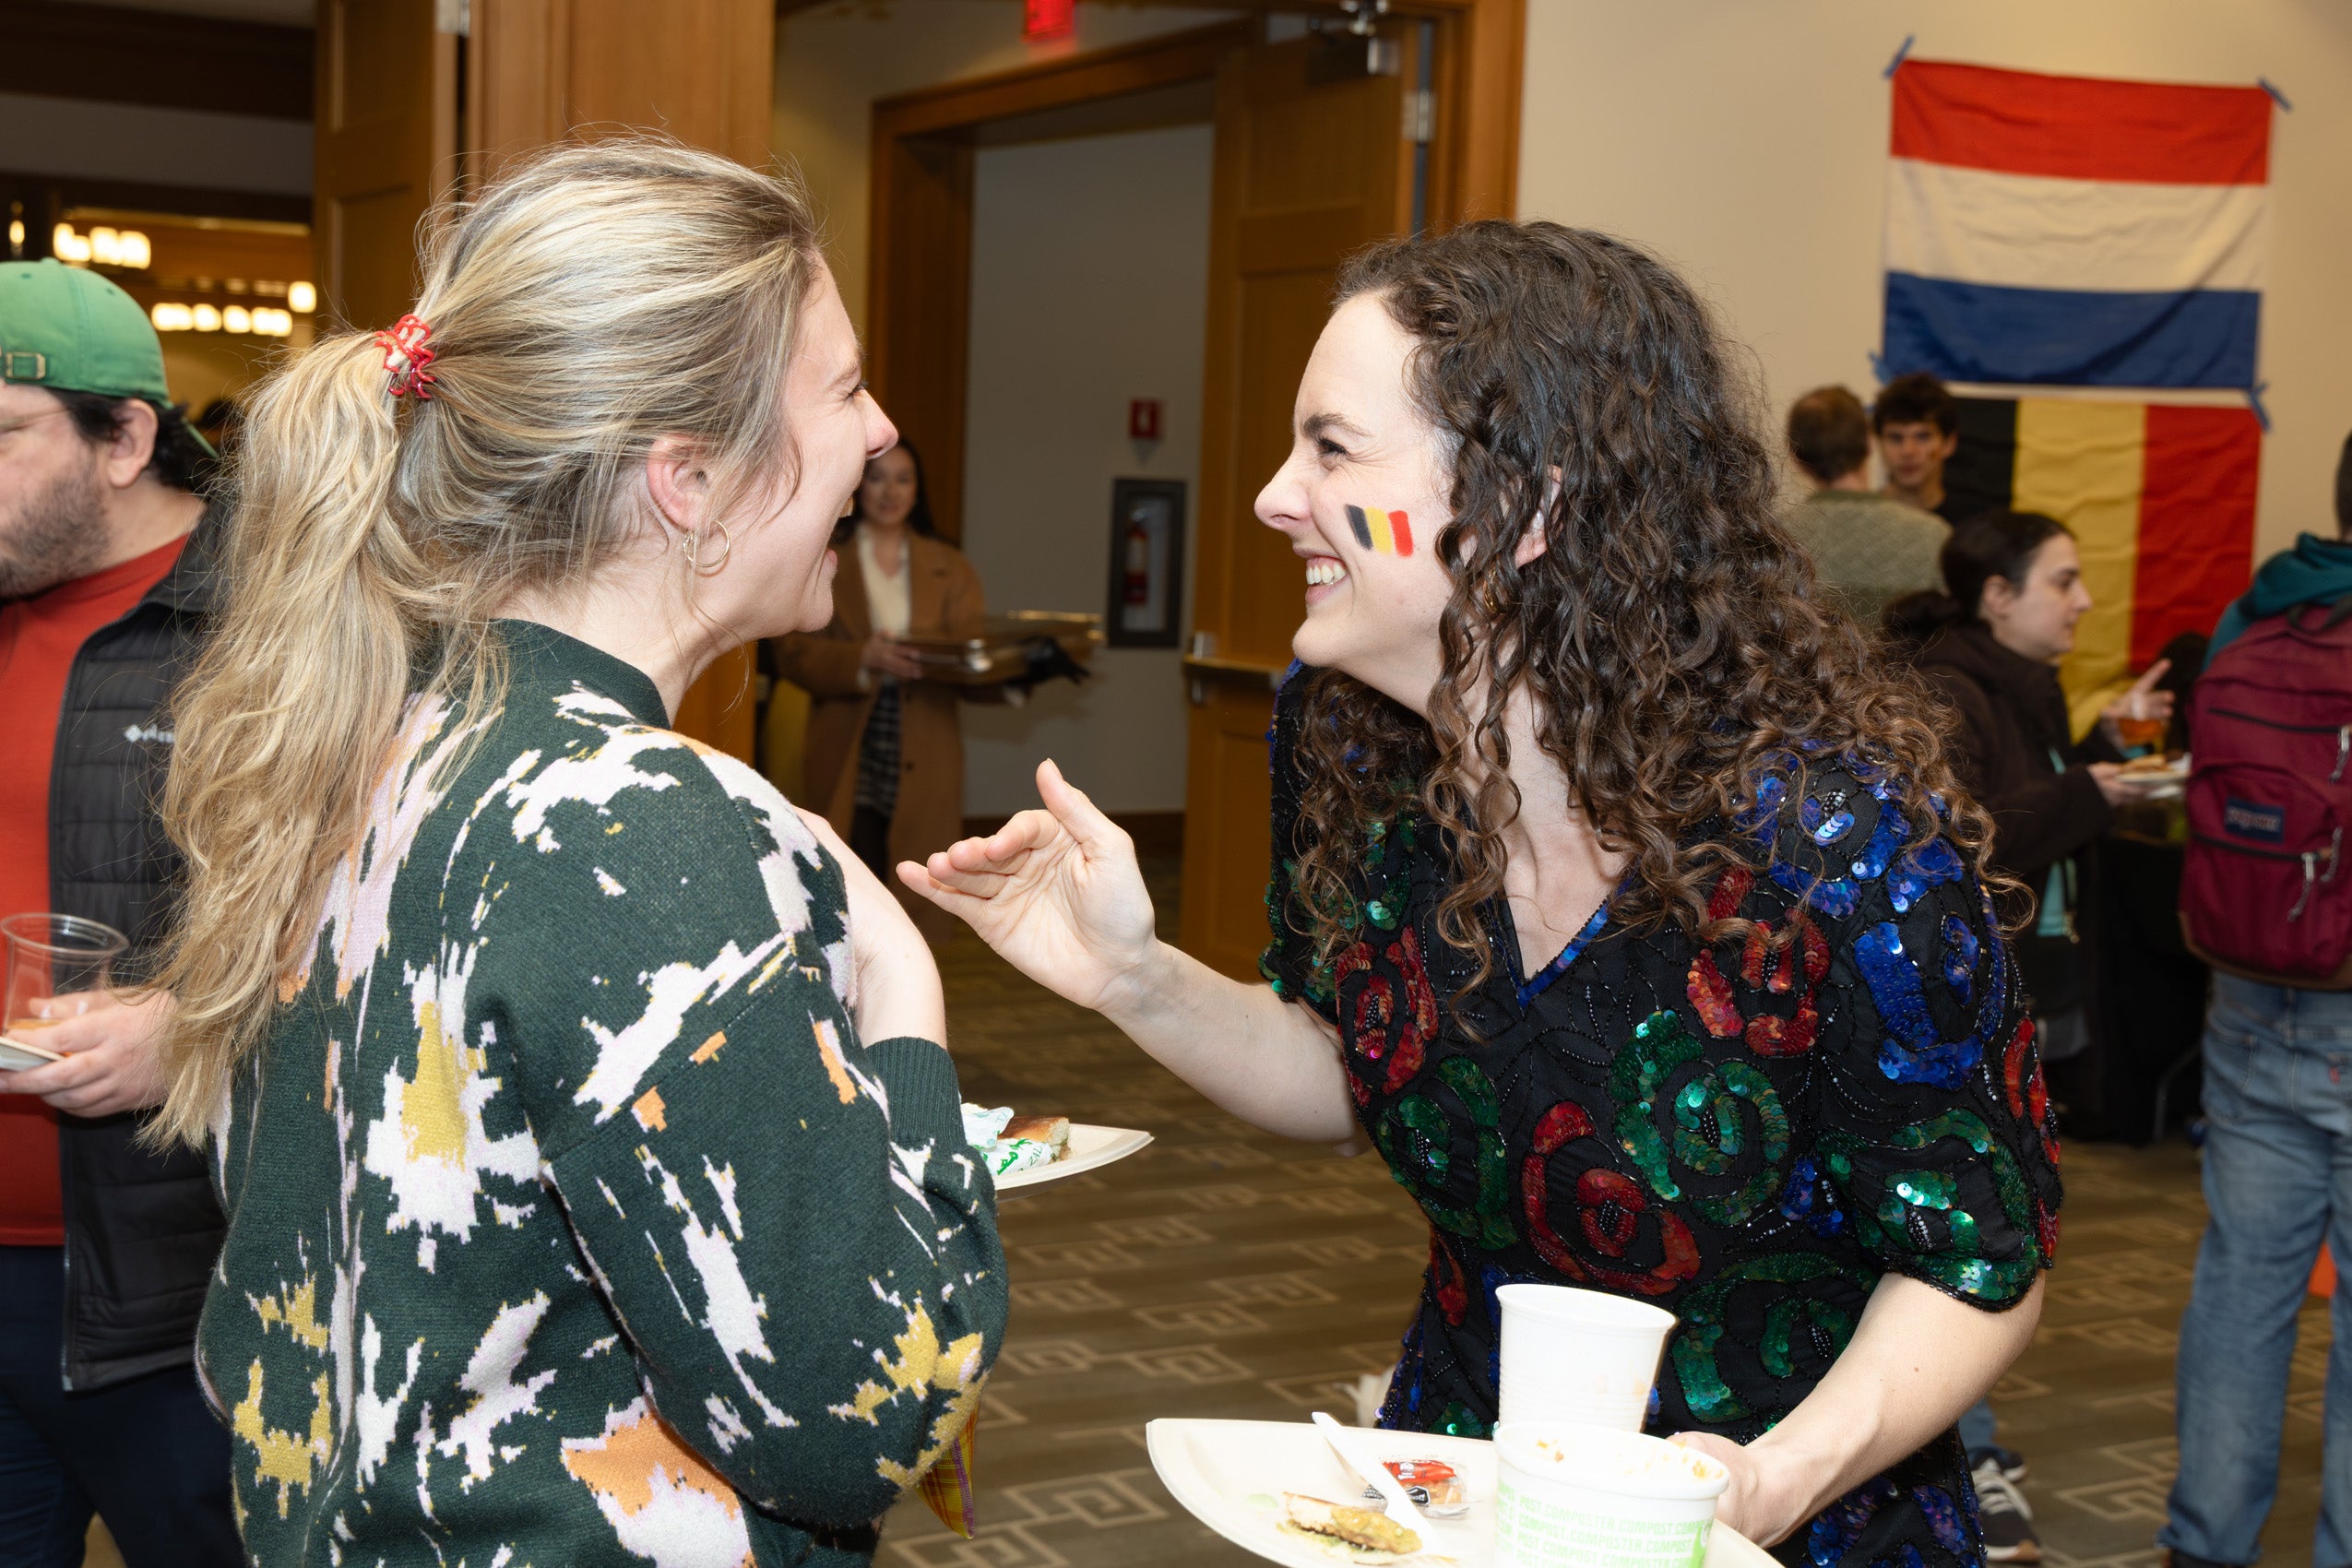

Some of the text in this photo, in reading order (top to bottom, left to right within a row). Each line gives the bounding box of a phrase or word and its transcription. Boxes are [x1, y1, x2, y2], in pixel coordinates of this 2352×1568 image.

[1519, 1513, 1565, 1540] COMPOST
[1571, 1529, 1643, 1552] COMPOSTER
[1646, 1538, 1692, 1554] COMPOST
[1520, 1495, 1542, 1513] POST
[1545, 1504, 1615, 1530] COMPOSTER
[1619, 1519, 1672, 1536] COMPOST
[1516, 1531, 1539, 1550] POST
[1543, 1541, 1598, 1565] COMPOST
